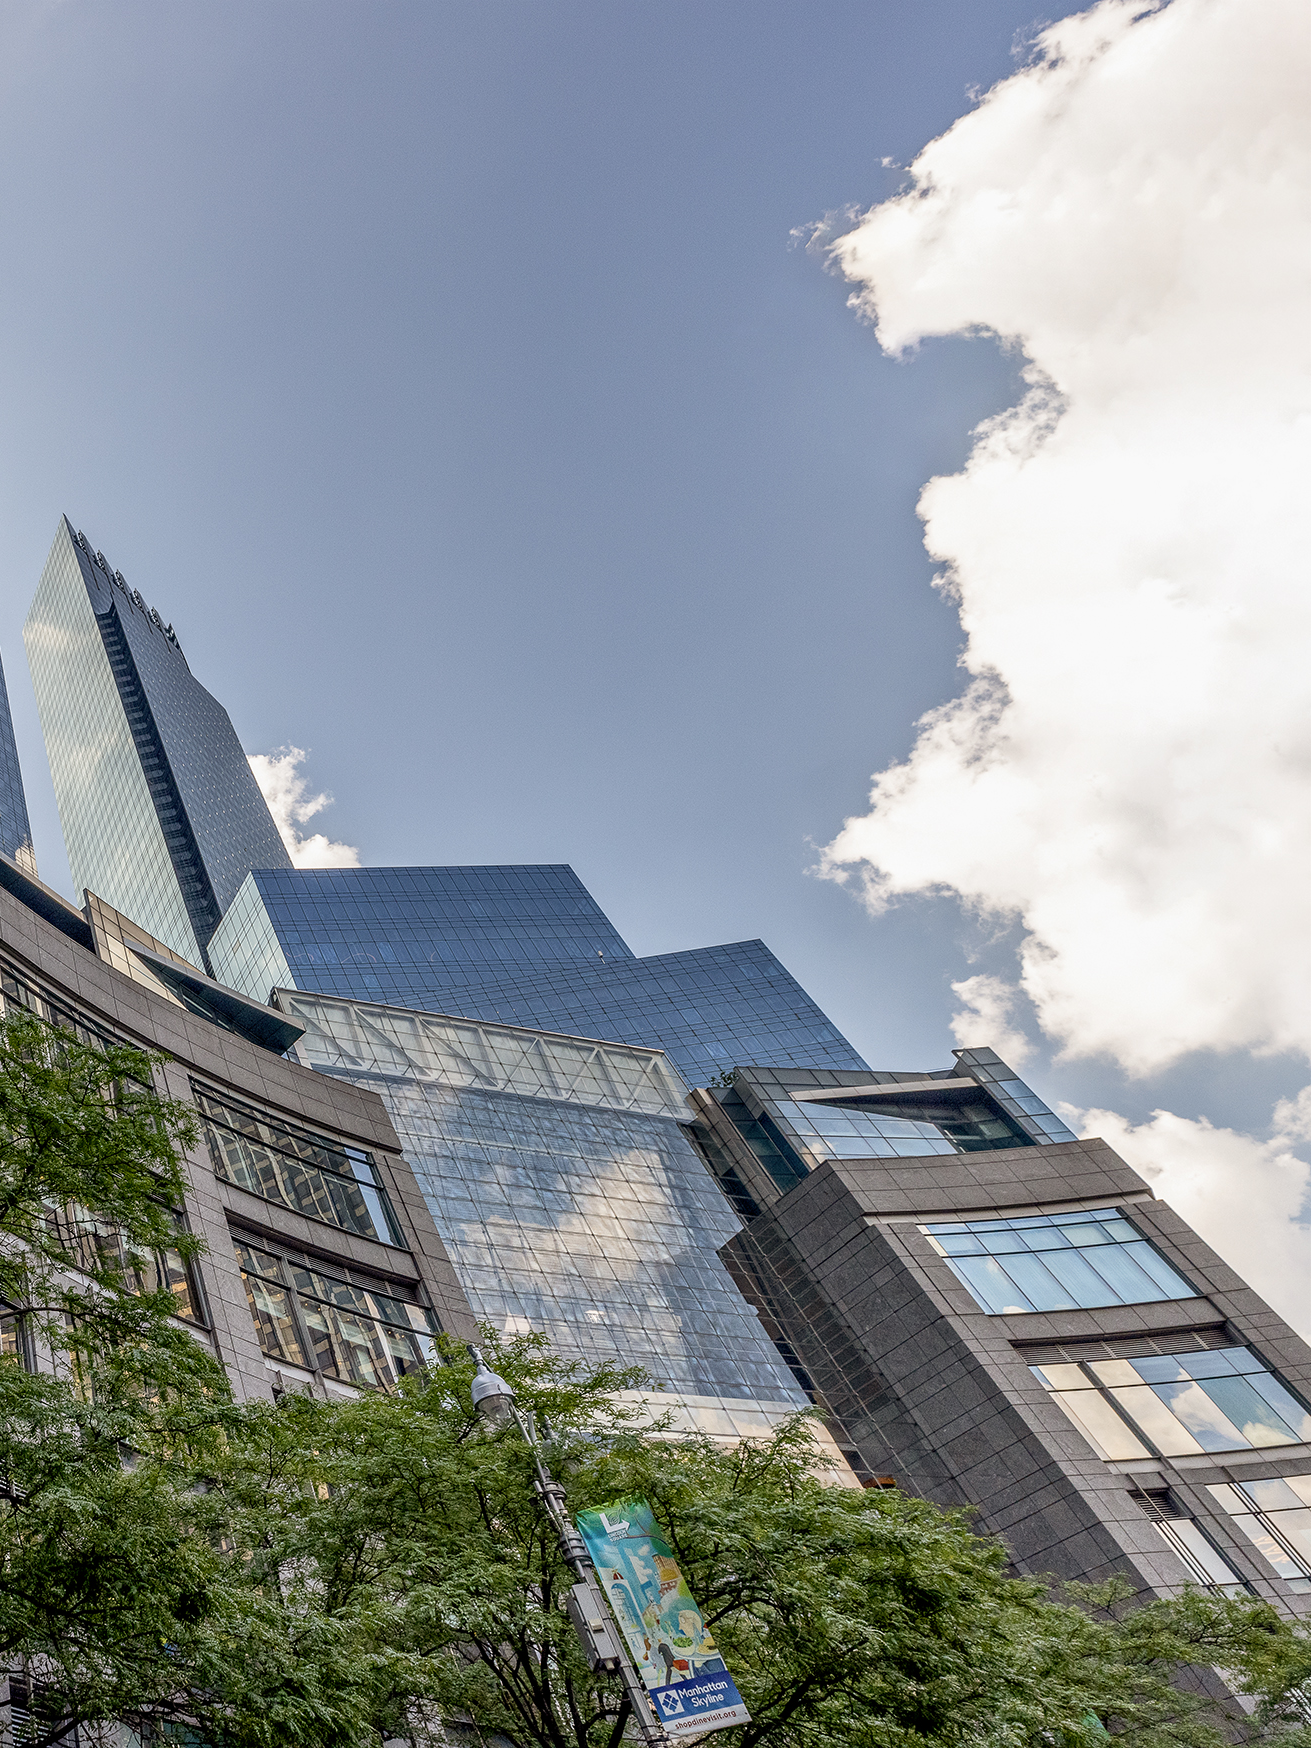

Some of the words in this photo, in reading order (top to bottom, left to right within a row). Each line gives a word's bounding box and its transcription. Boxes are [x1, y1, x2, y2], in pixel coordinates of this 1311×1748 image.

[677, 1681, 729, 1699] Manhattan
[691, 1693, 724, 1707] Skyline
[675, 1710, 737, 1729] shopdinevisit.org
